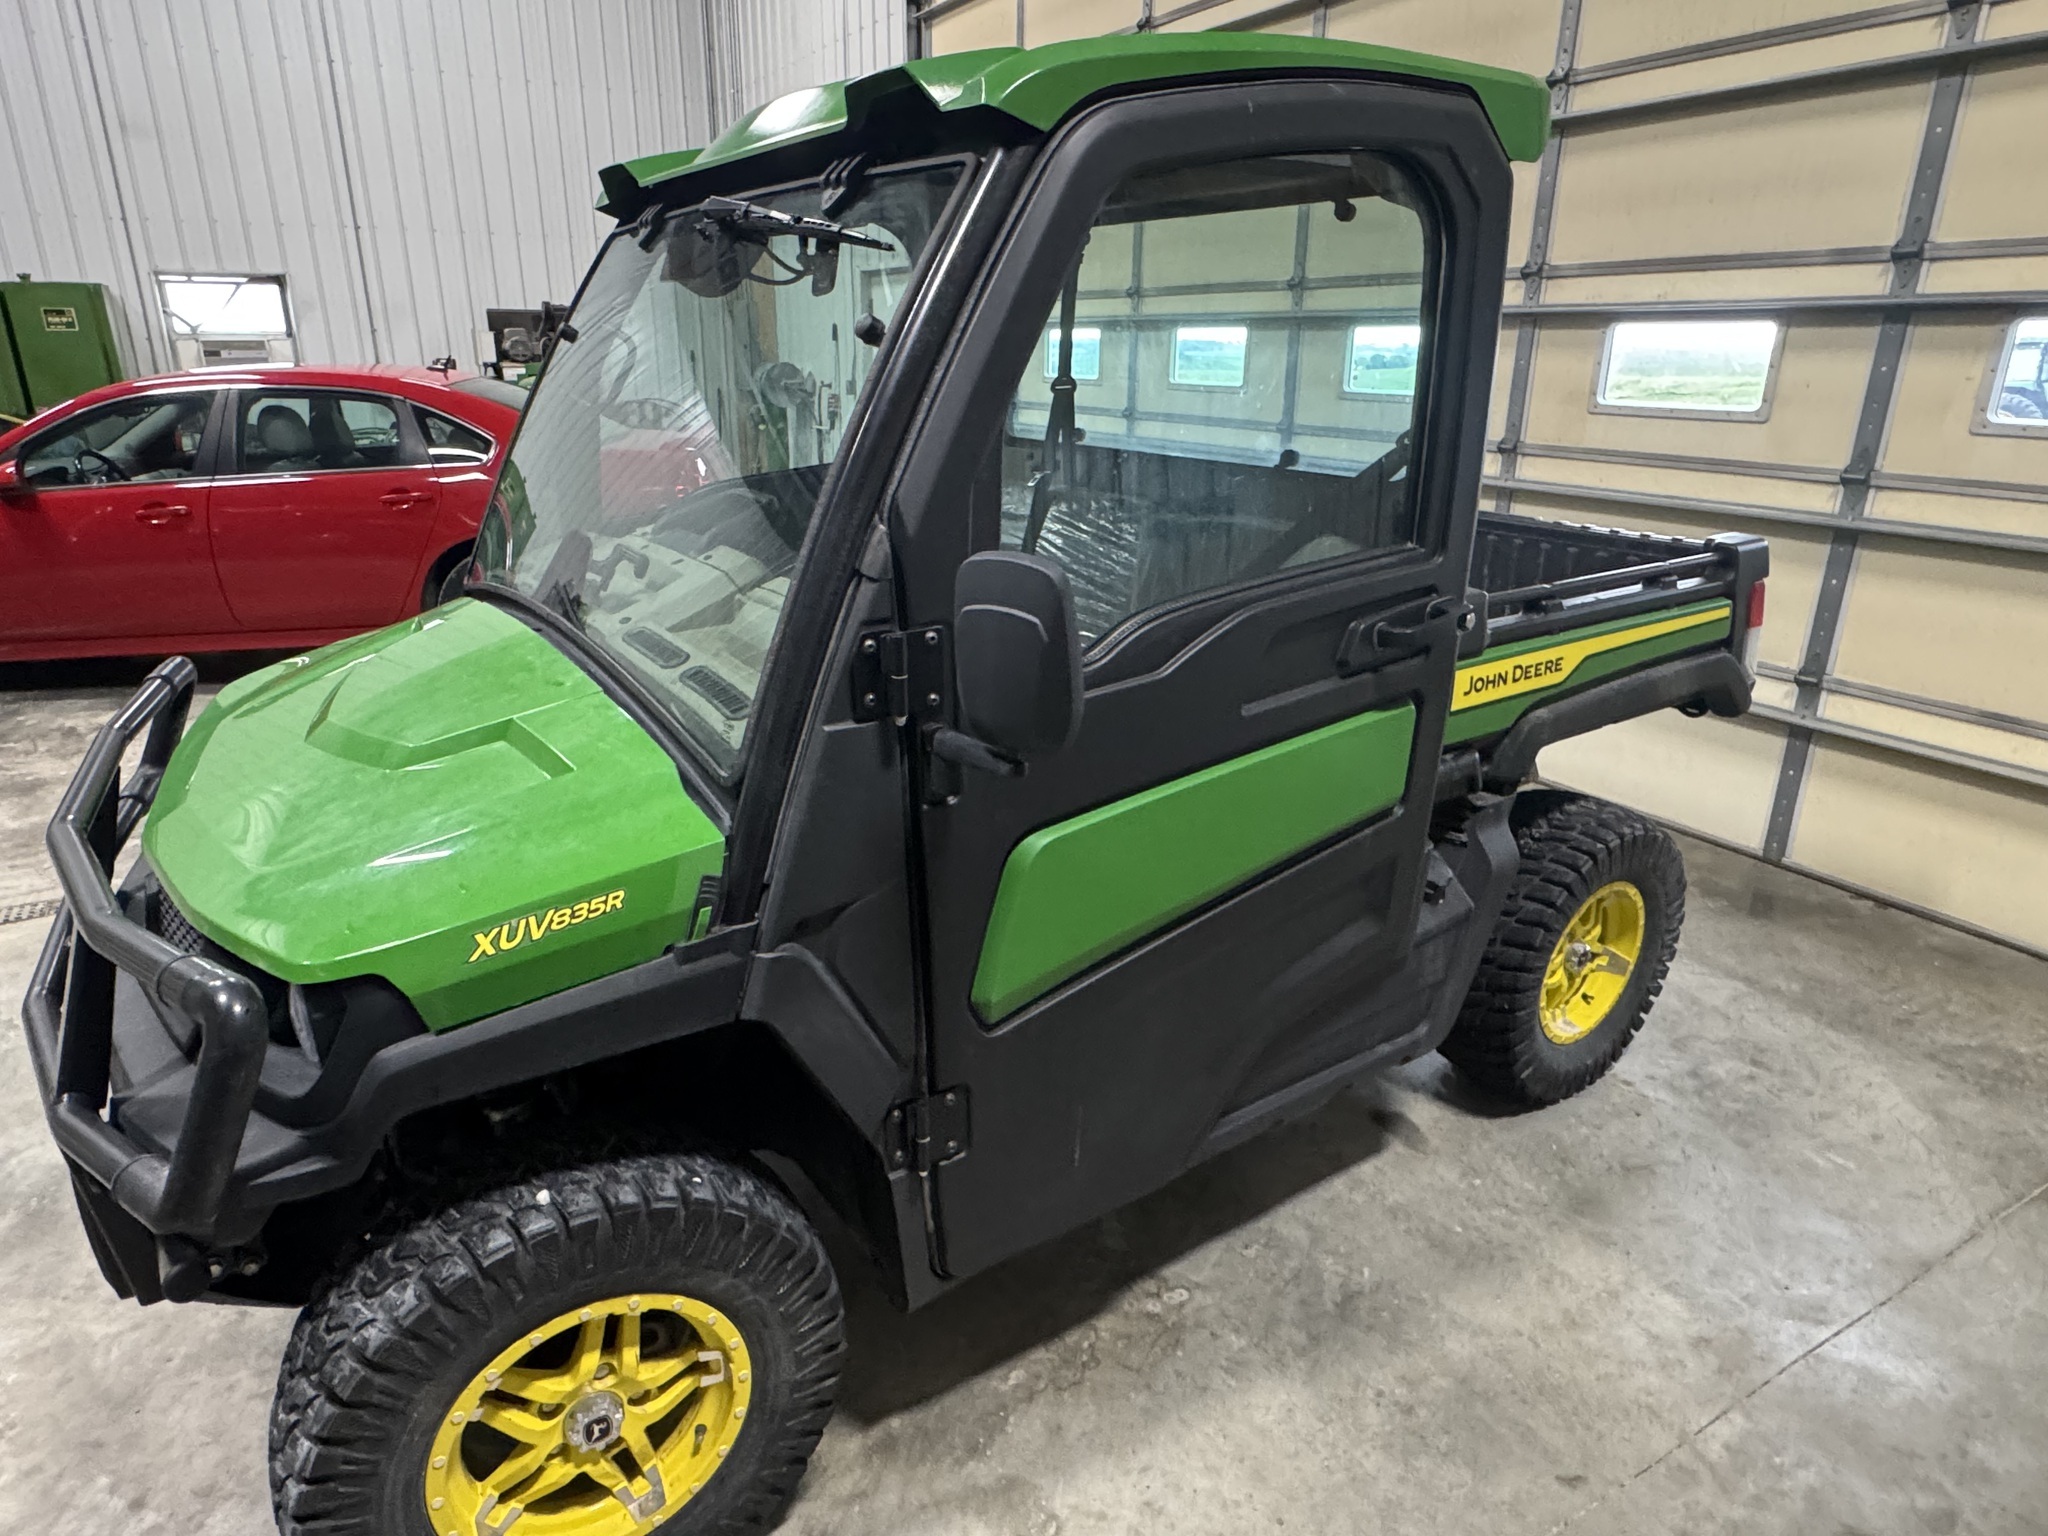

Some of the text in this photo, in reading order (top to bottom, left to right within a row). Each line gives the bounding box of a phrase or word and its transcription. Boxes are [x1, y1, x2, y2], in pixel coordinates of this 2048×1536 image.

[1463, 657, 1564, 697] JOHN DEERE
[467, 889, 626, 964] XUV835R
